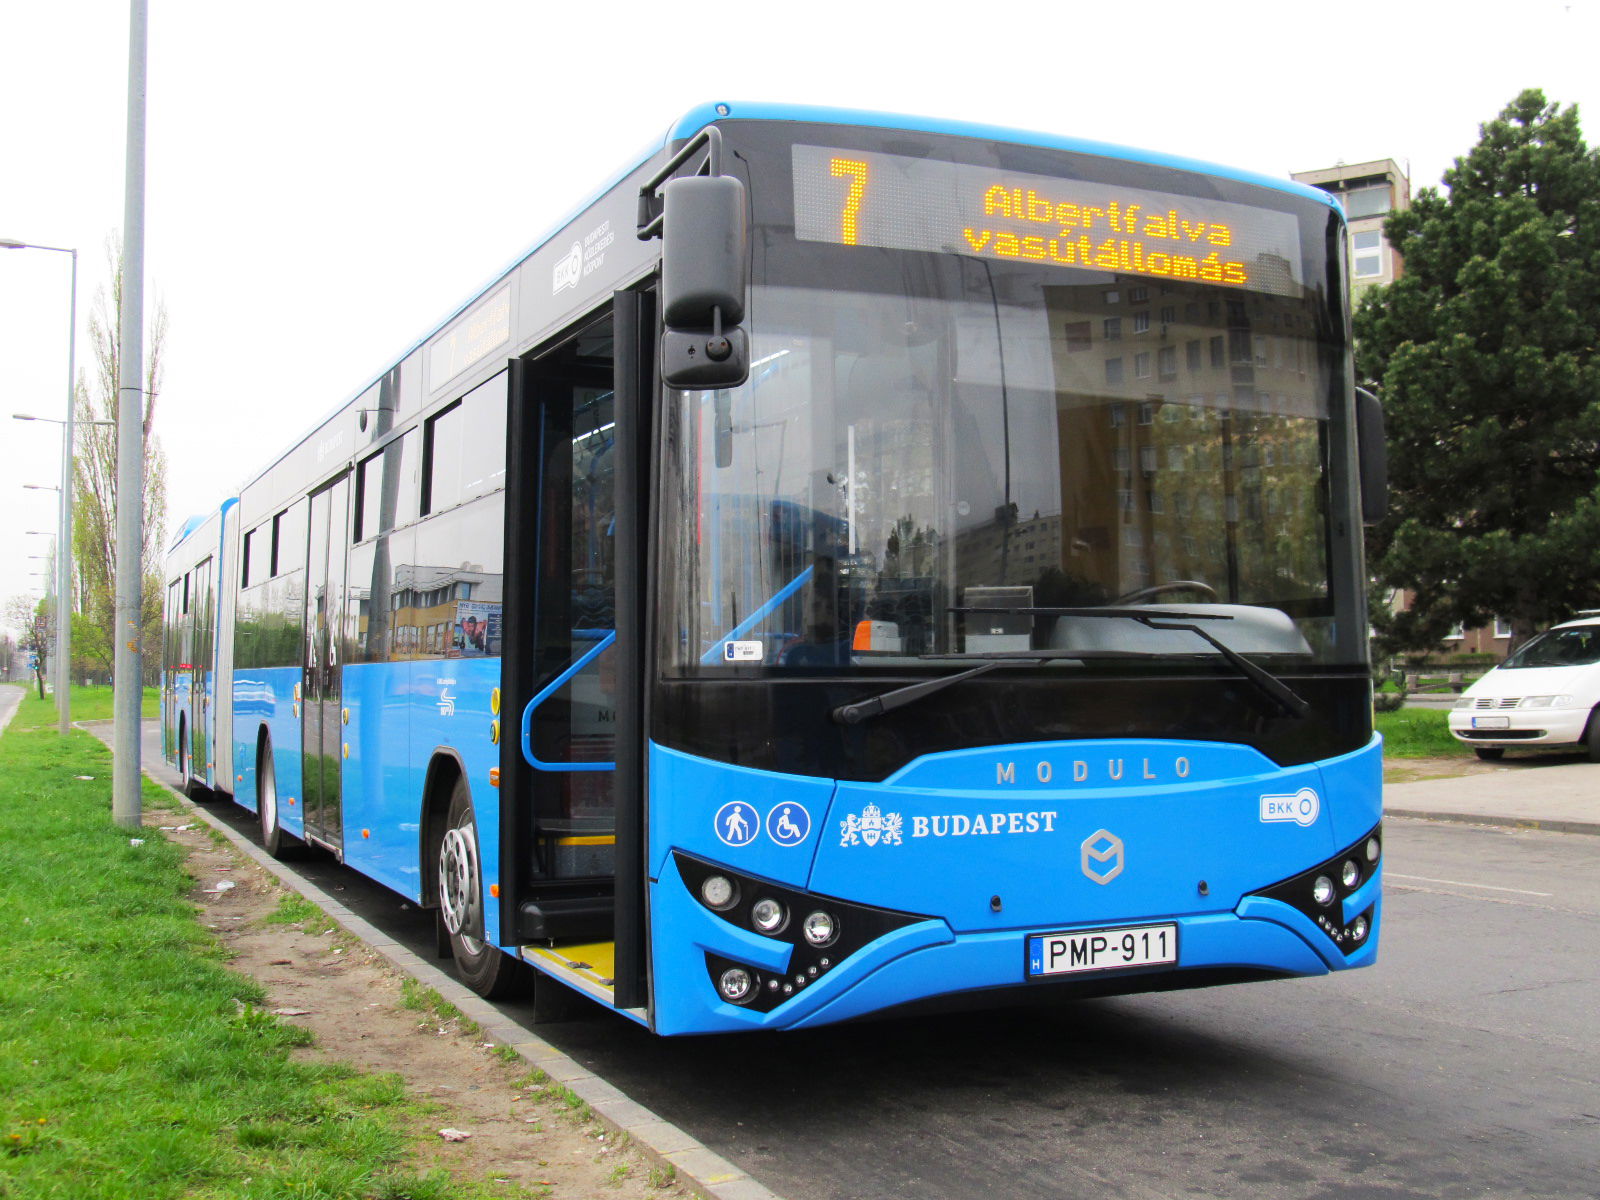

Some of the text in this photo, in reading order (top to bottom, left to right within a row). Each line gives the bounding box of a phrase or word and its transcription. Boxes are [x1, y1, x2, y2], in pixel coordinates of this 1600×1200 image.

[830, 158, 868, 246] 7
[983, 184, 1232, 247] Albertfalva
[963, 226, 1247, 285] vasútállomás
[996, 757, 1191, 785] MODULO
[912, 811, 1057, 838] BUDAPEST
[1050, 931, 1167, 969] PMP-911
